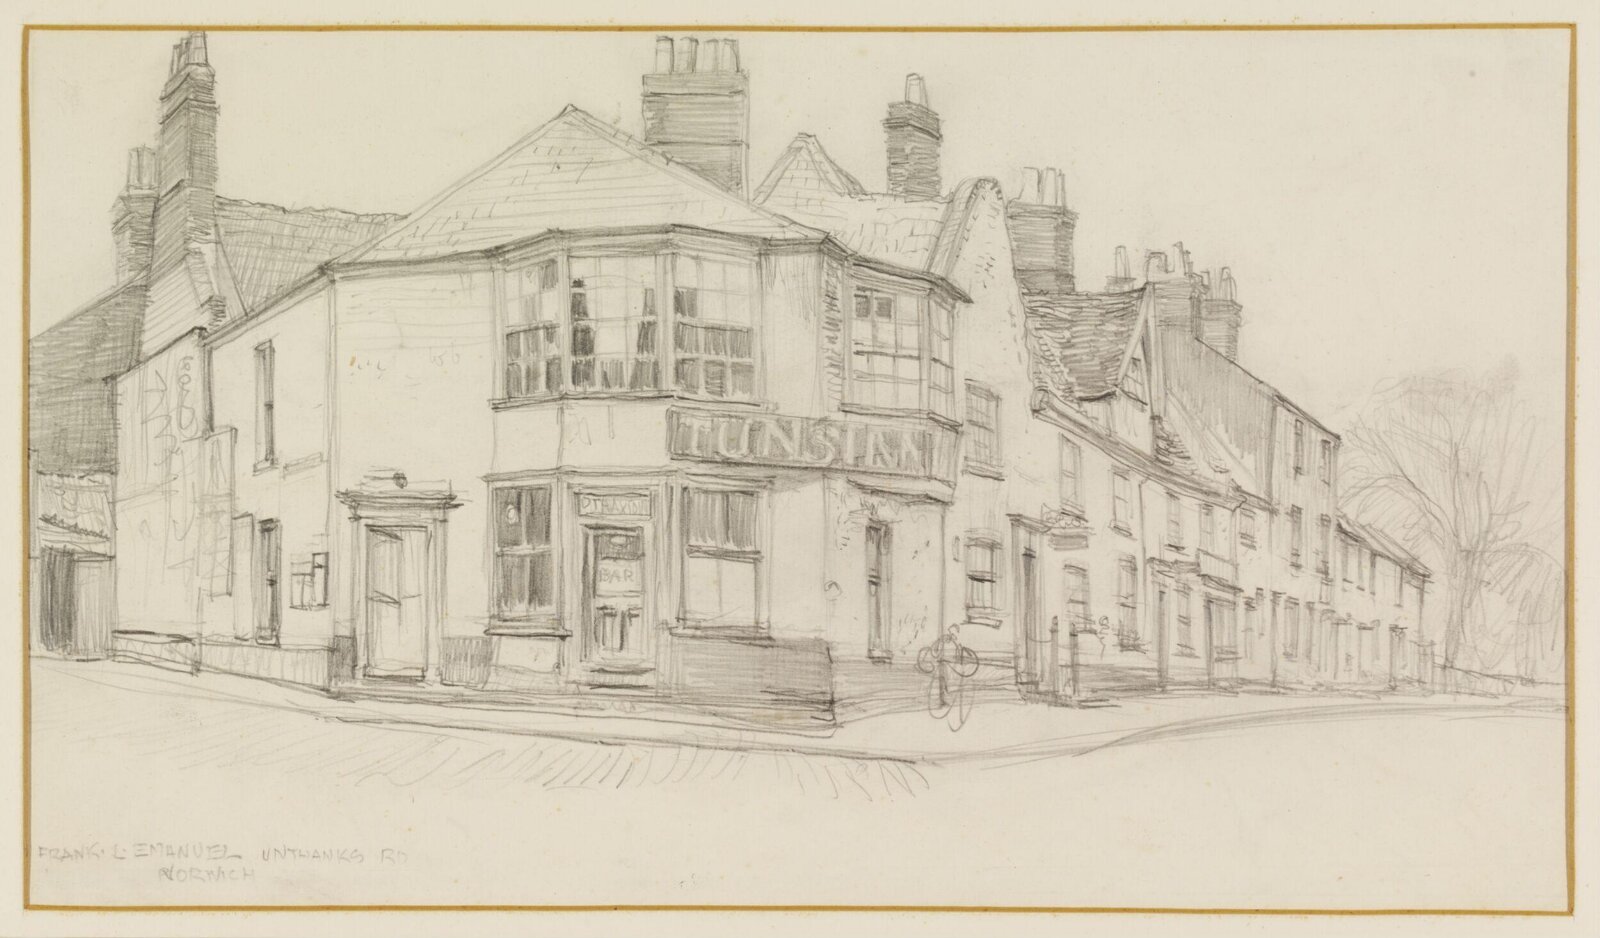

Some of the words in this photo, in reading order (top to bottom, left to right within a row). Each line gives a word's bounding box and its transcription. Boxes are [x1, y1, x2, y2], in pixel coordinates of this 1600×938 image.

[678, 415, 841, 467] TUNS
[598, 567, 635, 583] BAR
[133, 842, 242, 860] EMANUEL
[261, 845, 364, 864] UNTHANKS
[158, 863, 256, 882] NORWICH
